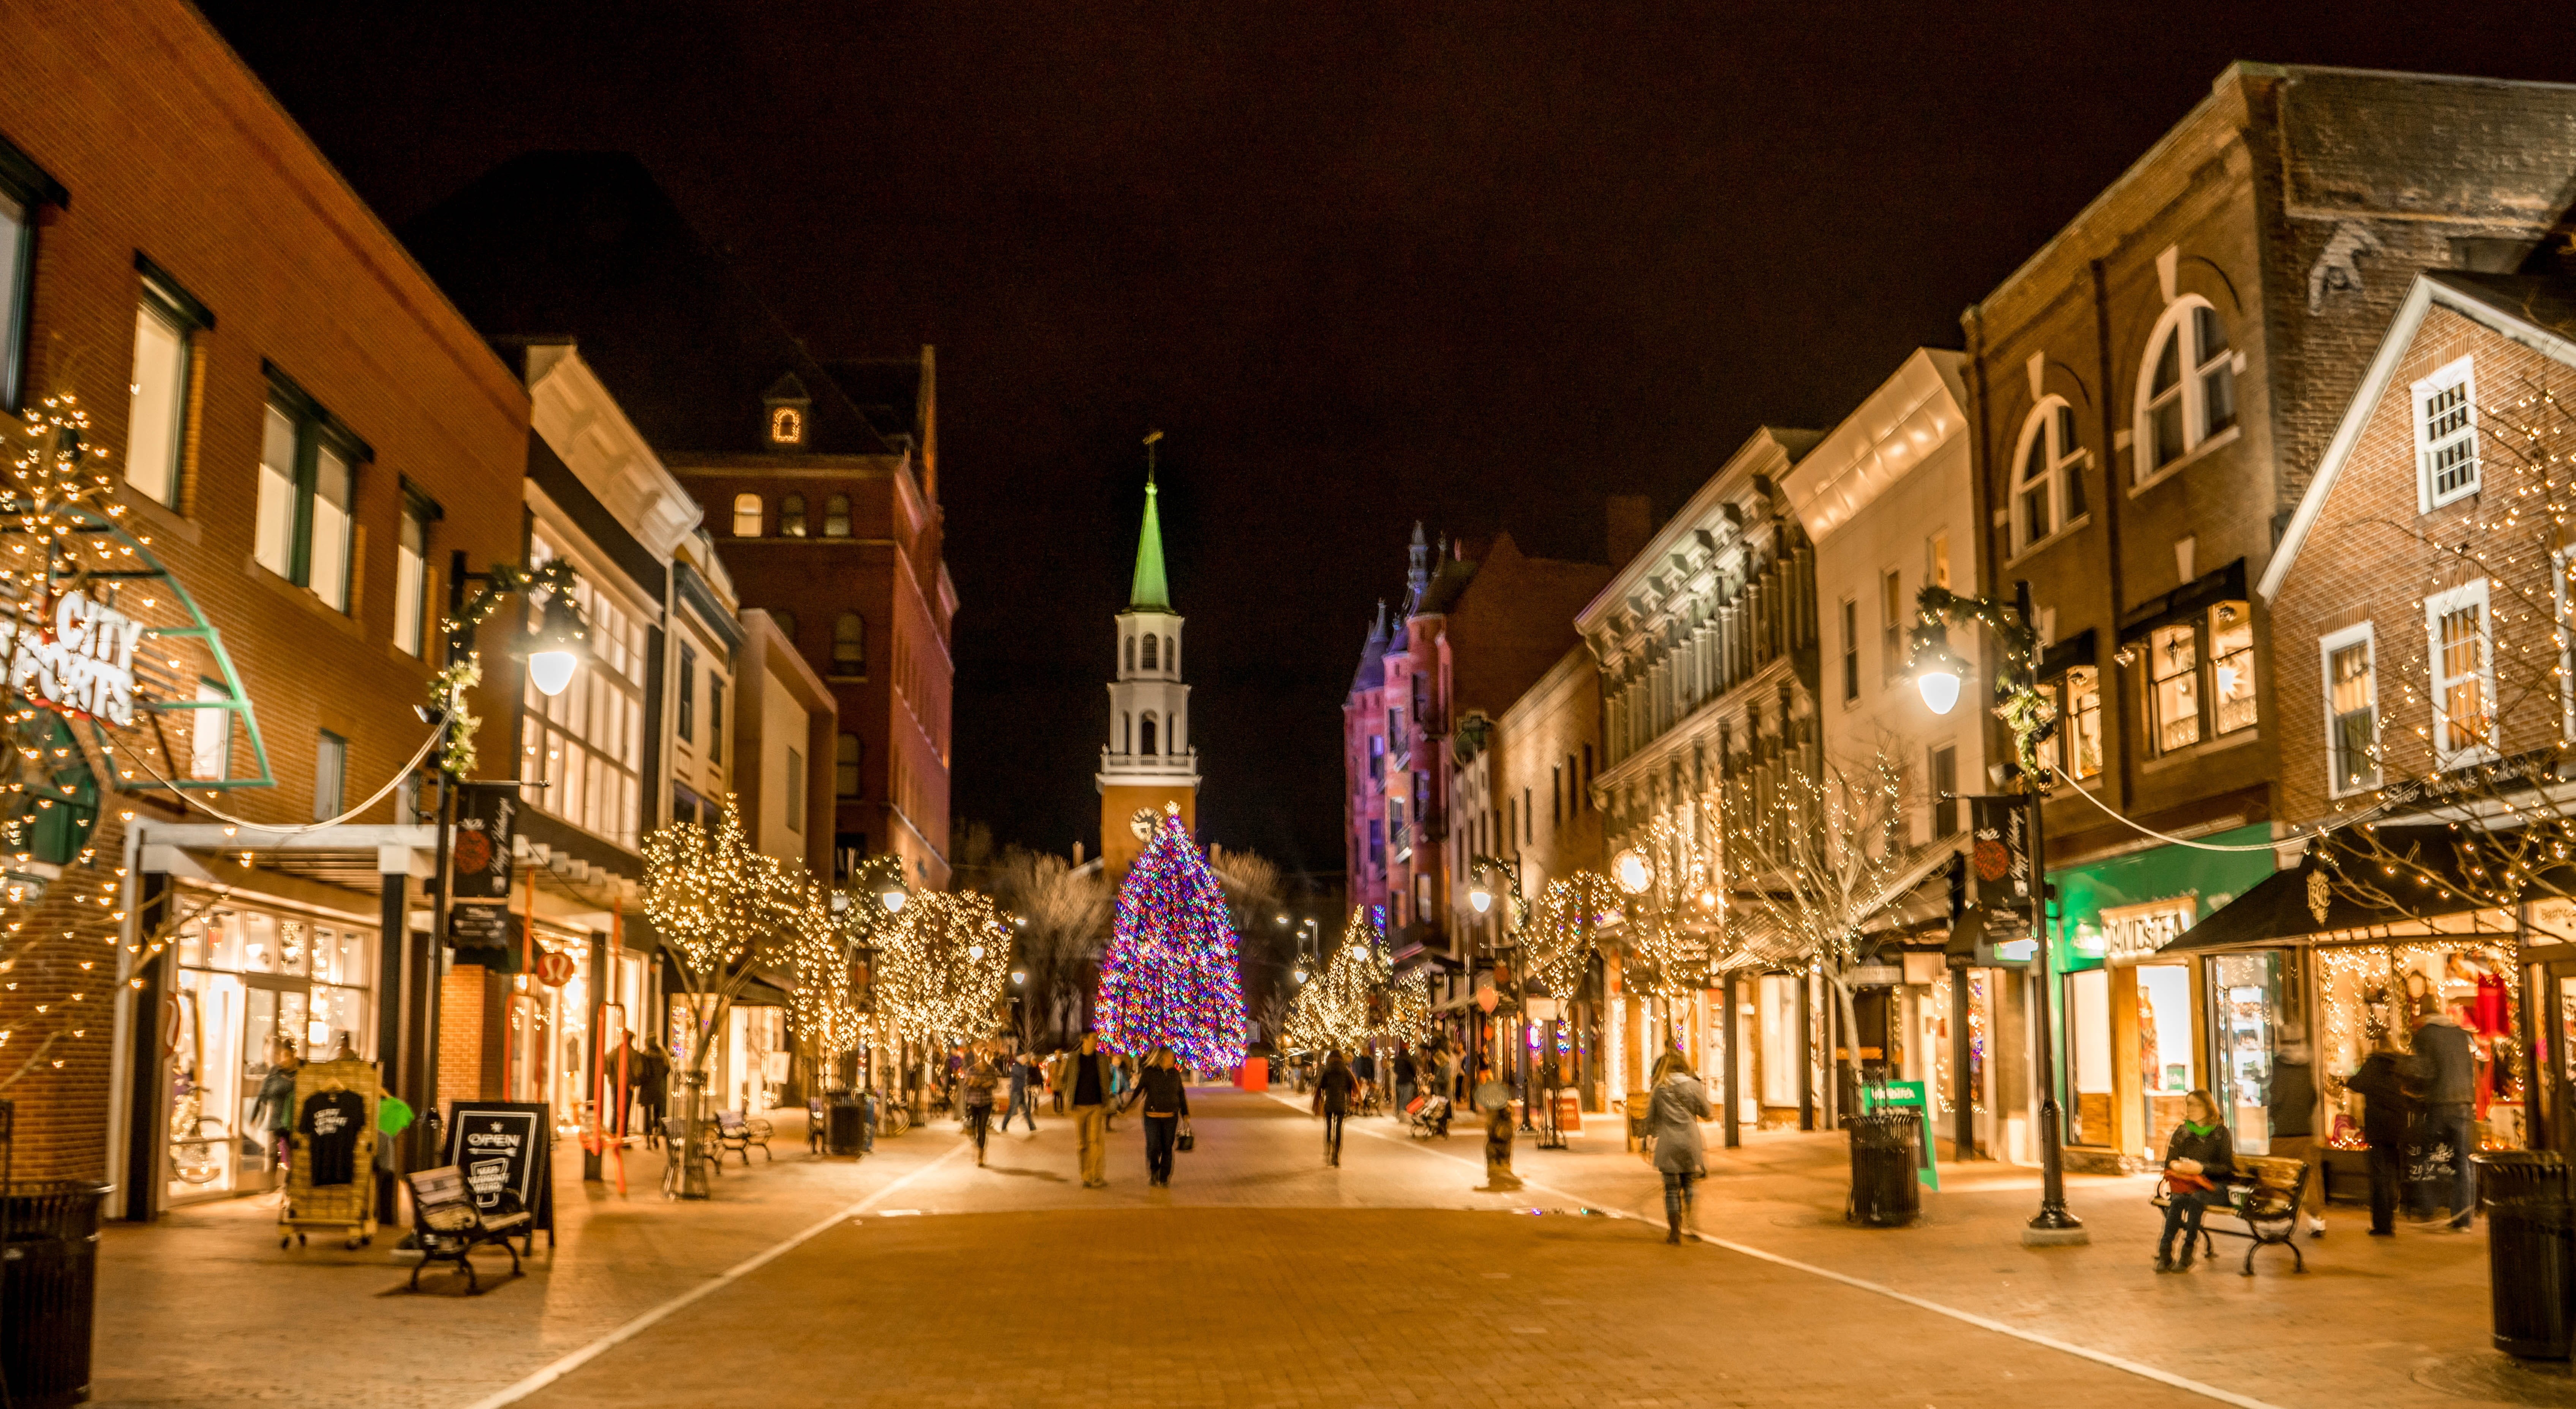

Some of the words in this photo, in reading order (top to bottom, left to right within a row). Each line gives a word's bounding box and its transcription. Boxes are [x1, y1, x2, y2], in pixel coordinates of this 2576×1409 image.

[56, 591, 144, 671] CITY
[467, 1133, 521, 1147] OPEN
[477, 1165, 501, 1175] KEEP
[467, 1173, 511, 1184] VERMONT
[473, 1182, 503, 1194] WEIRD
